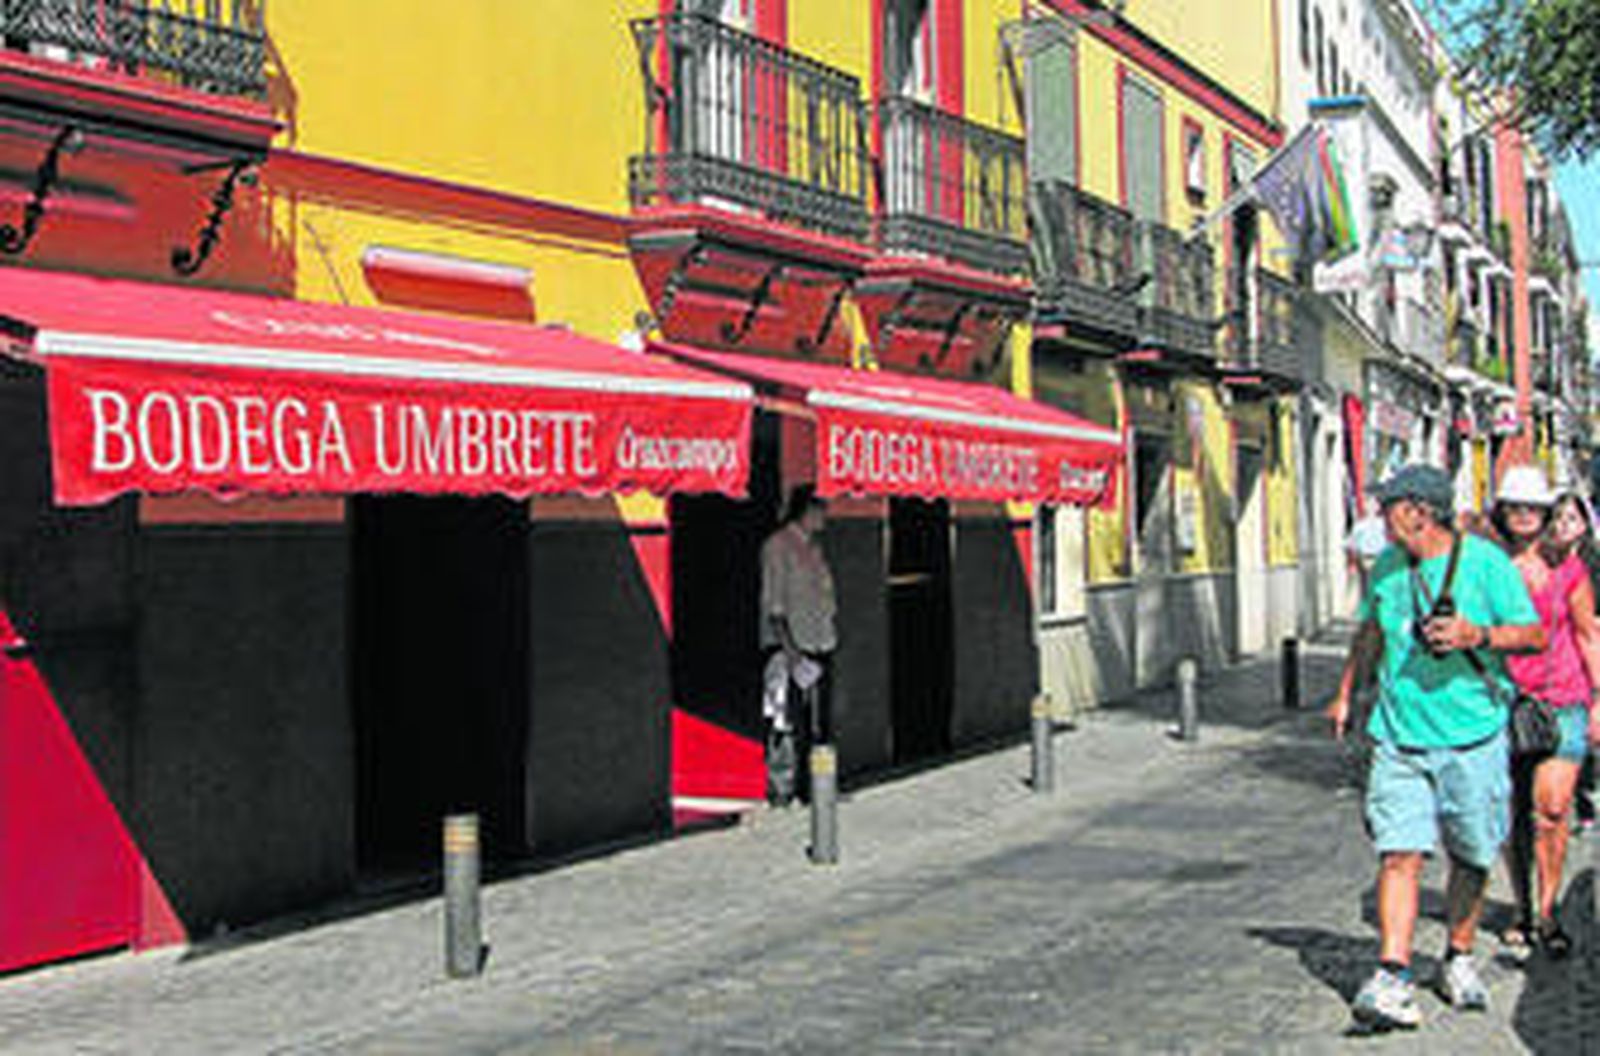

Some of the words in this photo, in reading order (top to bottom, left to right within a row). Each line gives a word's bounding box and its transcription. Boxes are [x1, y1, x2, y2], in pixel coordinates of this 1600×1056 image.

[87, 389, 354, 475] BODEGA
[369, 403, 598, 477] UMBRETE
[829, 424, 938, 484] BODEGA
[941, 437, 1040, 493] UMBRETE
